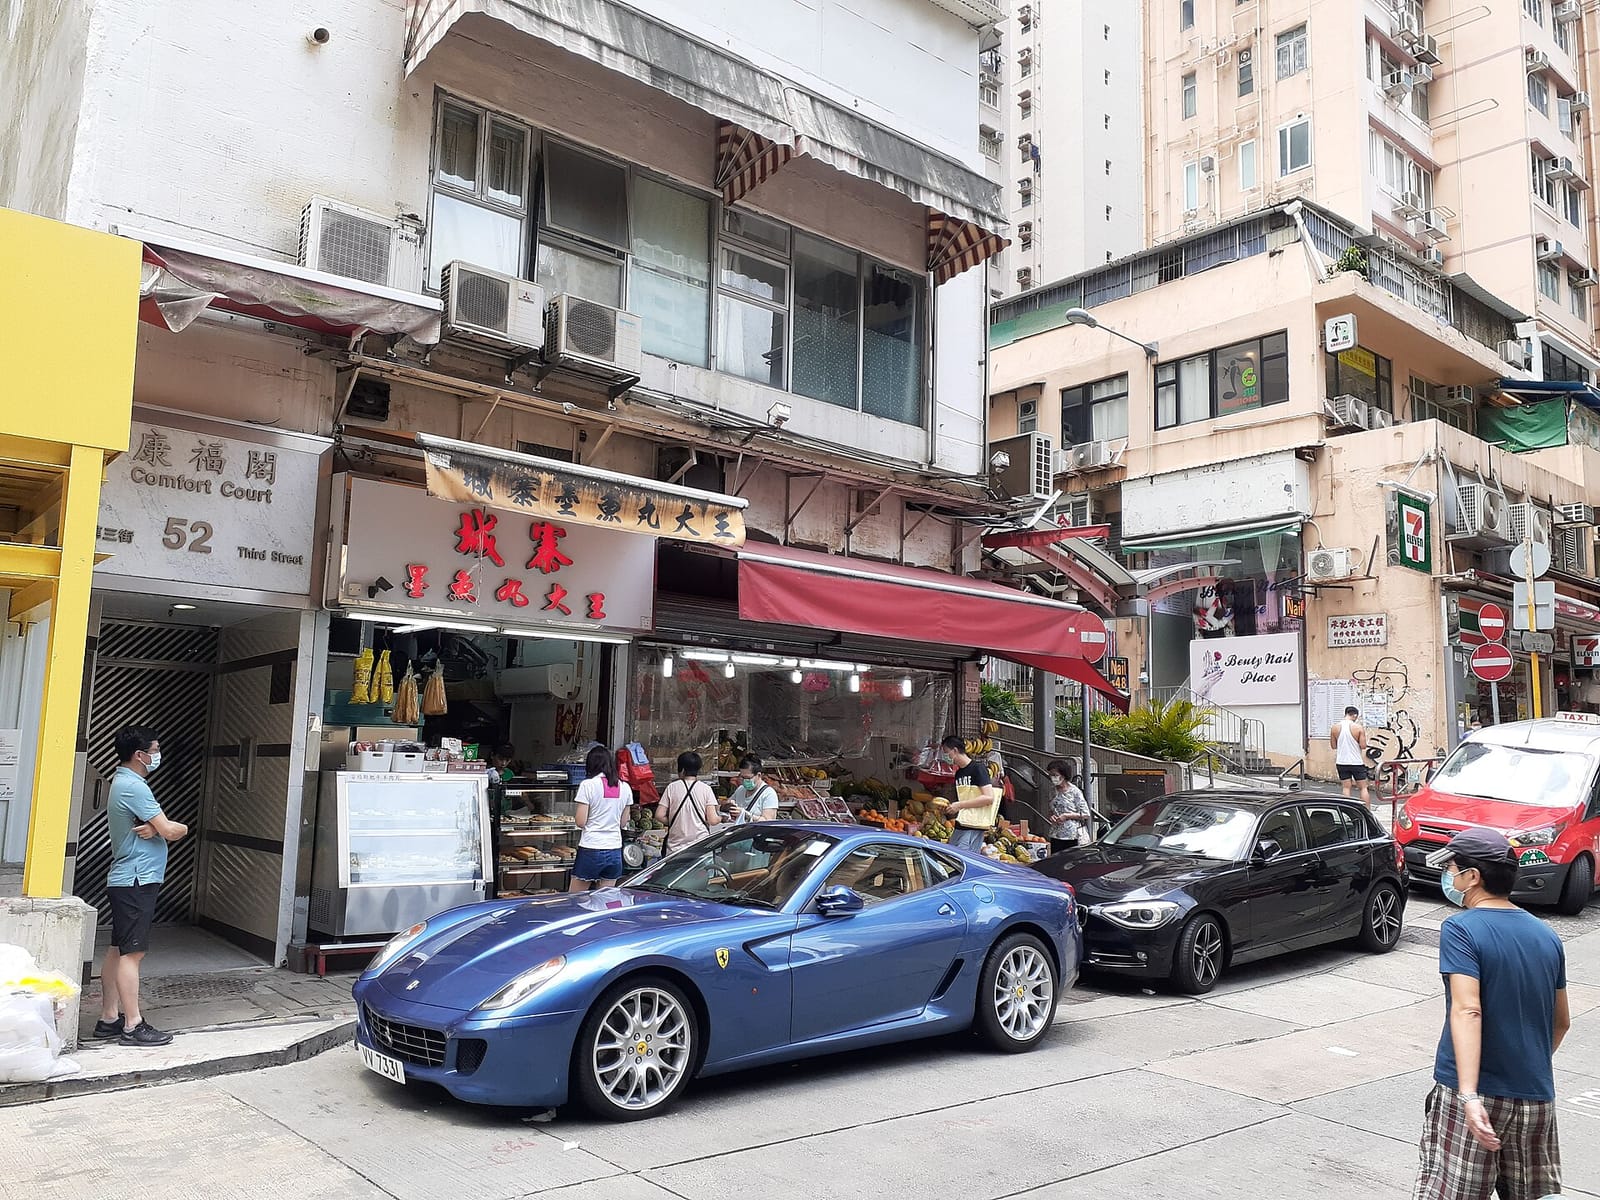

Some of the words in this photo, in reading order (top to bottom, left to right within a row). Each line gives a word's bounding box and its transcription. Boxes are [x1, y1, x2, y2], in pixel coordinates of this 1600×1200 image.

[132, 428, 278, 485] 康福閣
[131, 466, 212, 495] Comfort
[220, 480, 273, 504] Court
[162, 517, 214, 554] 52
[237, 546, 267, 561] Third
[270, 550, 304, 566] Street
[1286, 596, 1304, 617] Nail
[1111, 660, 1126, 675] Nail
[1264, 652, 1294, 665] Nail
[1240, 671, 1277, 684] Place
[1563, 713, 1589, 721] TAXI
[376, 1053, 400, 1080] 7331
